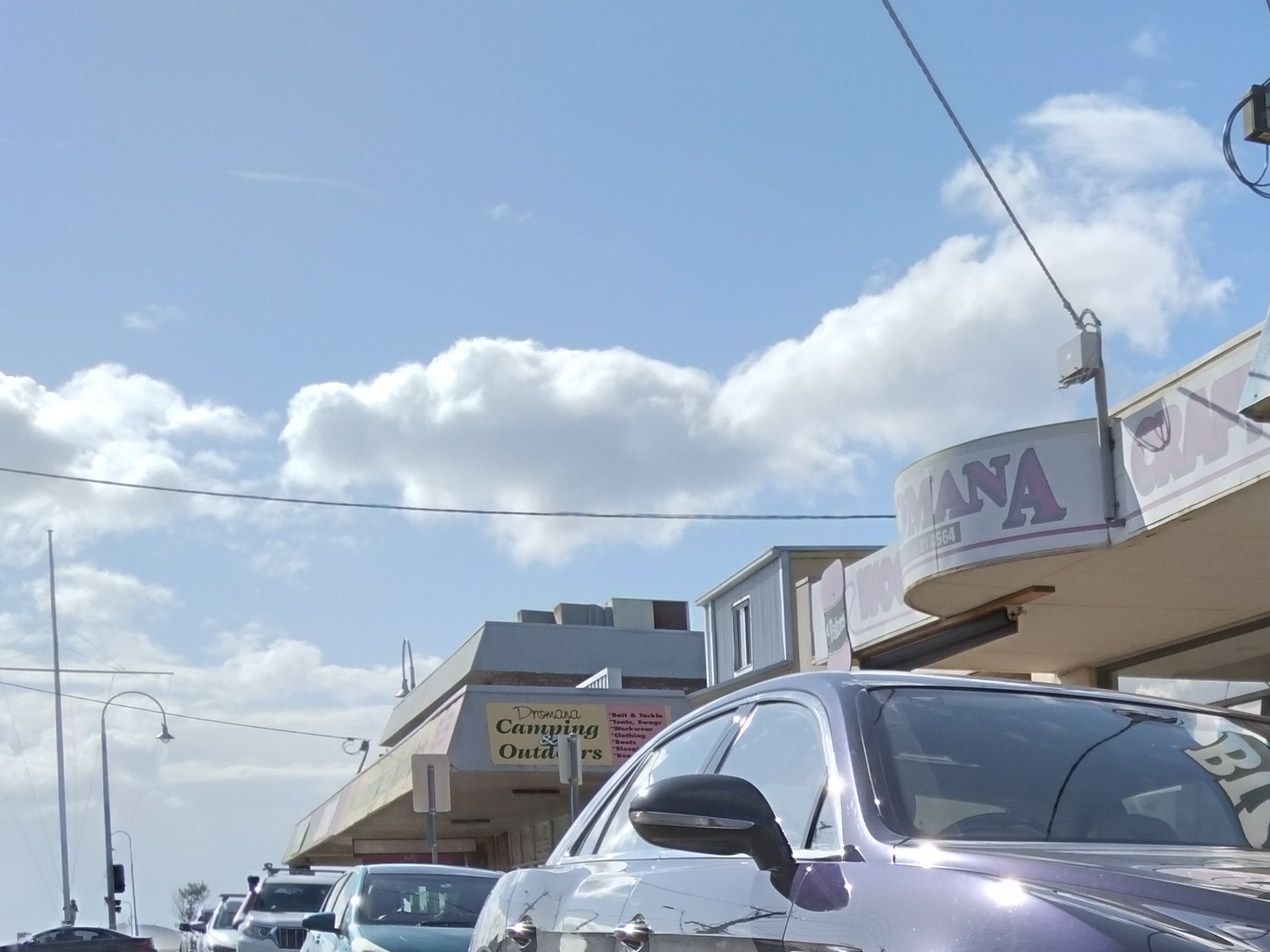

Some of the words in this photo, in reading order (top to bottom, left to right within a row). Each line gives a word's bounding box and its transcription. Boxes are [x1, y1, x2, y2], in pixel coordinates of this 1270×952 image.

[513, 705, 582, 720] Dromana
[496, 719, 599, 740] Camping
[499, 743, 603, 760] Outdrs
